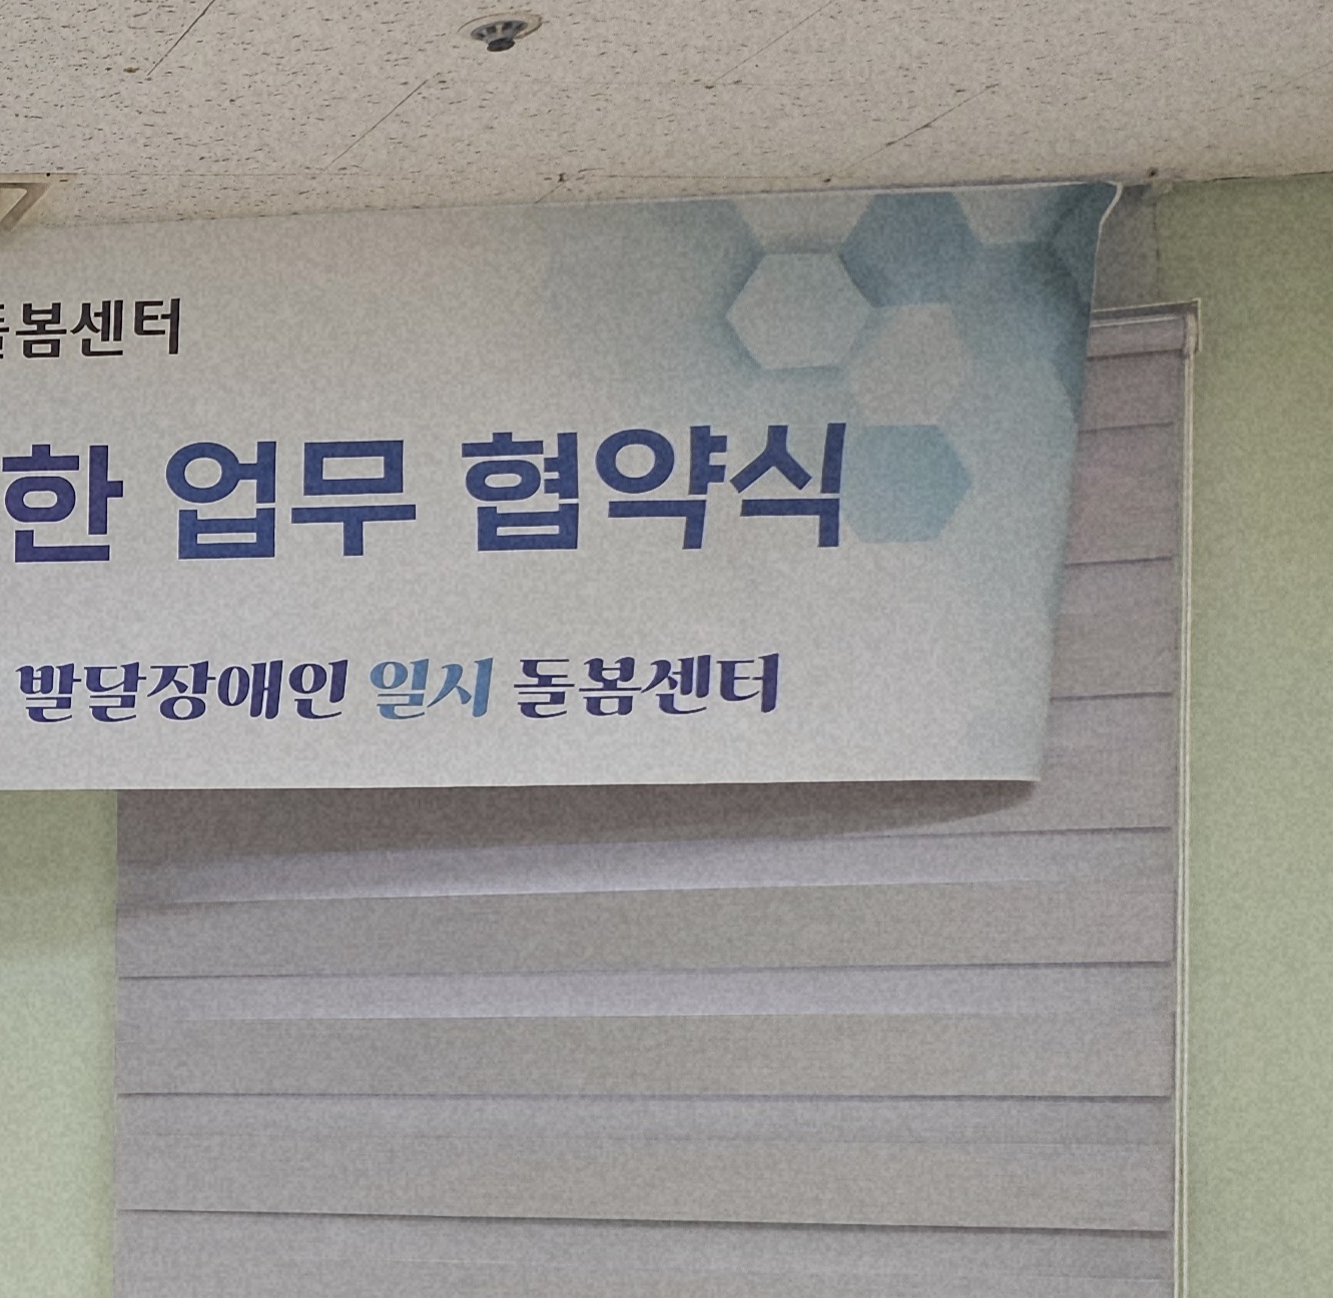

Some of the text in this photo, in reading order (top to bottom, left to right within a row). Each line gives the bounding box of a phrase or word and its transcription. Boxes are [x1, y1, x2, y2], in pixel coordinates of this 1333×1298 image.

[165, 439, 417, 560] 업무
[461, 421, 848, 552] 협약식
[15, 658, 349, 724] 발달장애인
[369, 657, 494, 721] 일시
[512, 652, 781, 720] 돌봄센터
